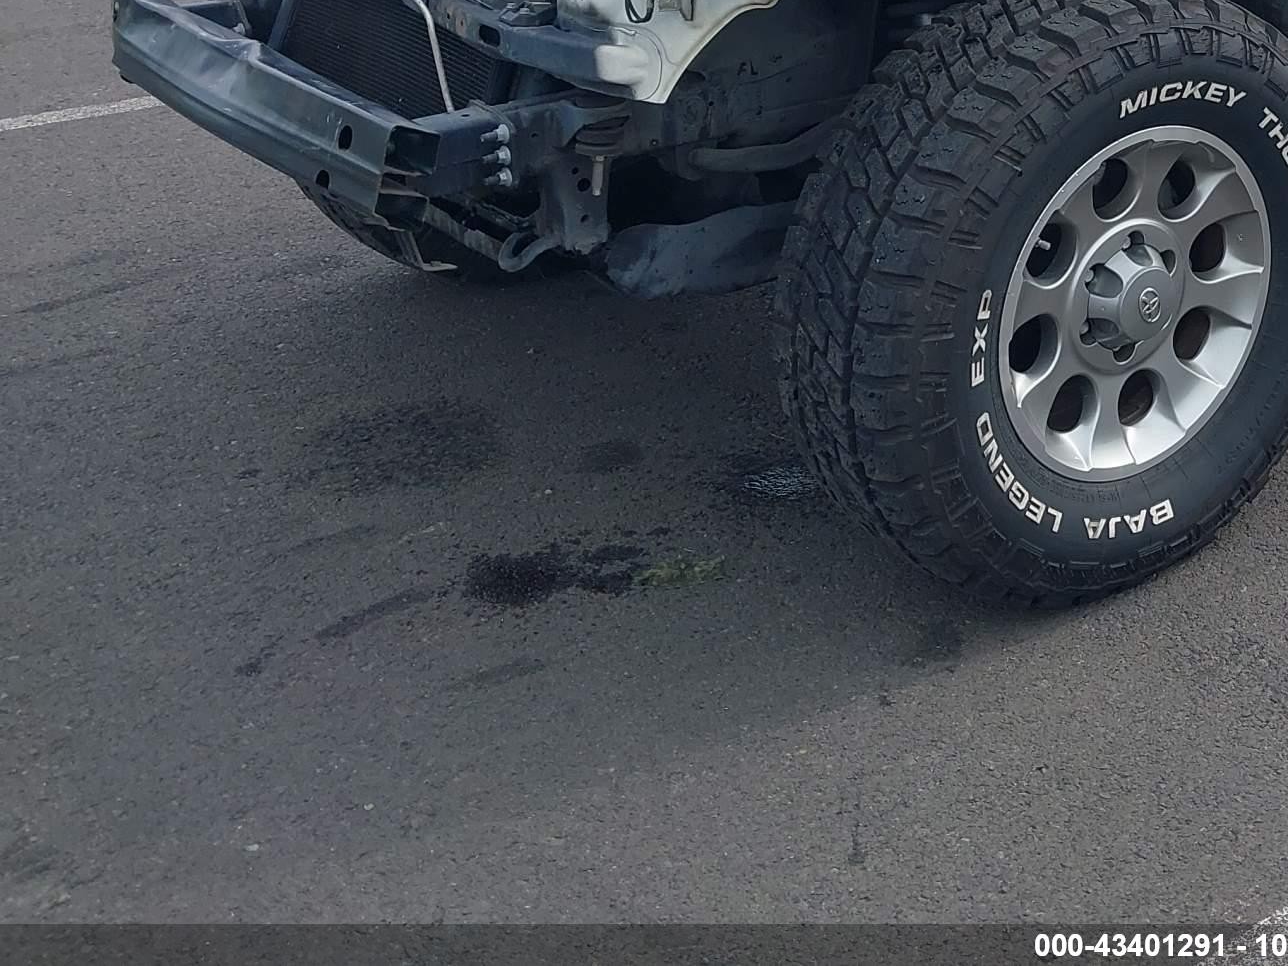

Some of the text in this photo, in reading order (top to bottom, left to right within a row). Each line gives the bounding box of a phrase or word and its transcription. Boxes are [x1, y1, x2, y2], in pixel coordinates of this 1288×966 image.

[1119, 81, 1247, 119] MICKEY
[970, 289, 994, 387] EXP
[976, 412, 1063, 533] LEGEND
[1083, 499, 1175, 540] BAJA
